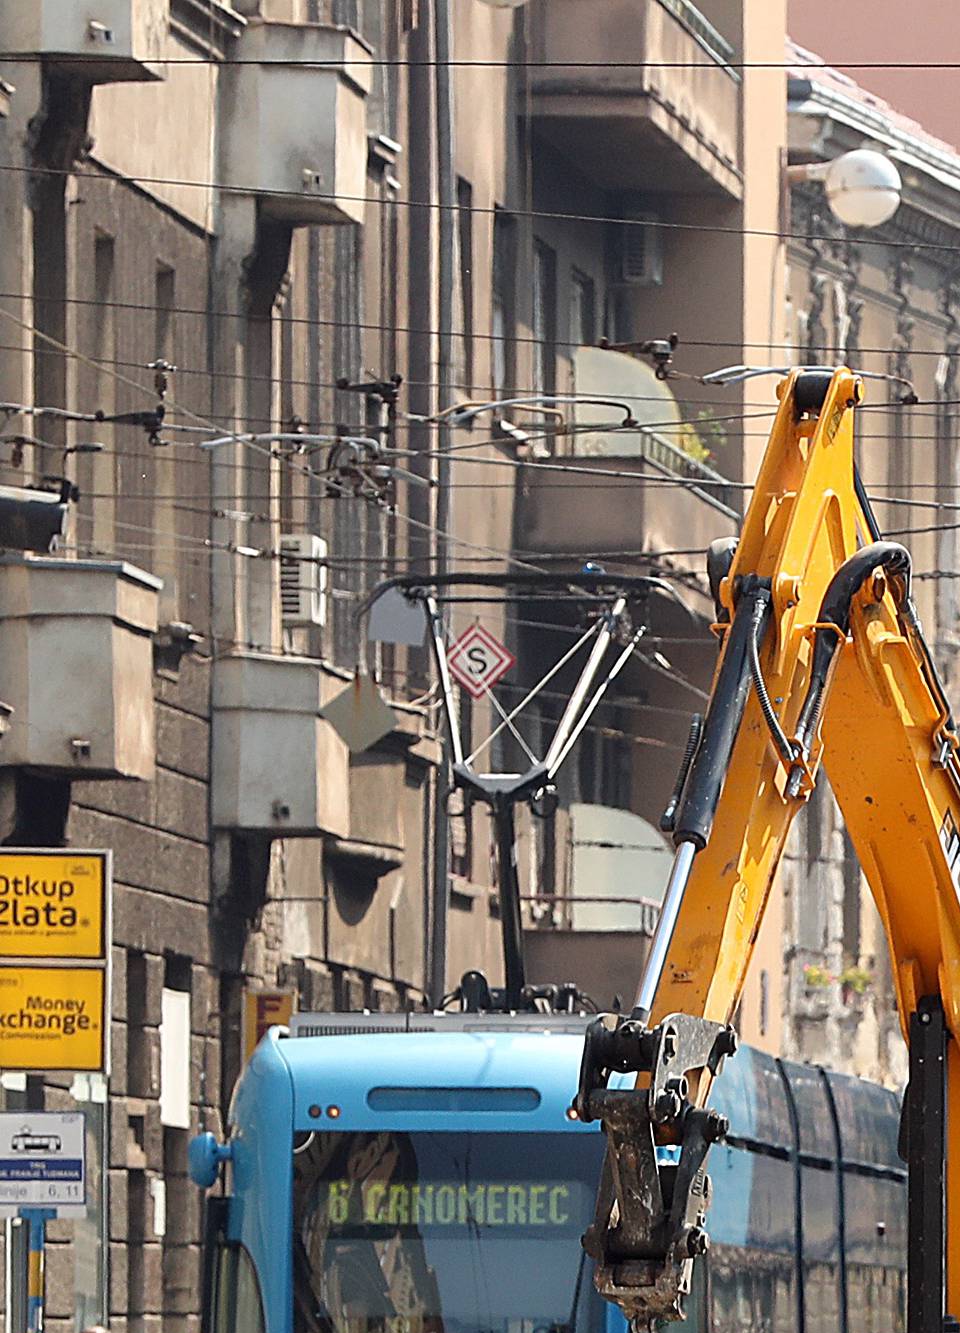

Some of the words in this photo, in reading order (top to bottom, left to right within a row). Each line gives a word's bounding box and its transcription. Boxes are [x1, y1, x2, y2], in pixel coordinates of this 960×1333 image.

[467, 647, 487, 674] S
[26, 996, 86, 1015] Money
[328, 1179, 350, 1225] 6
